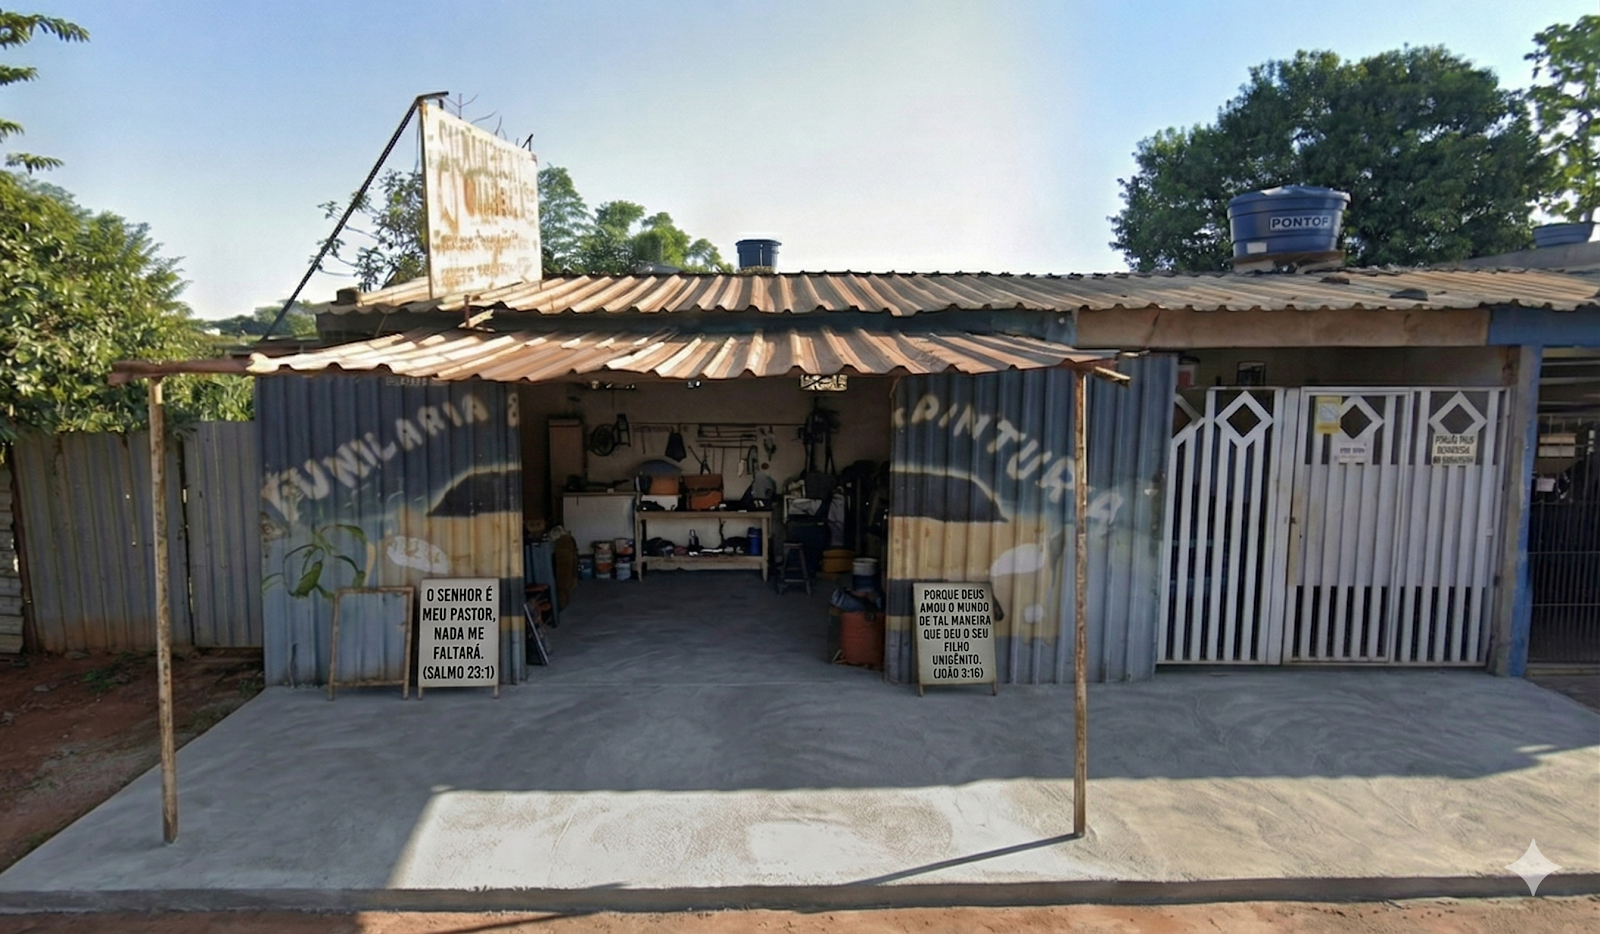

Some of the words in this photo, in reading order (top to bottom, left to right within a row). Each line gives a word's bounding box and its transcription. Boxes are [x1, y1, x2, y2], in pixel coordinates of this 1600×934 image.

[1272, 216, 1329, 228] PONTOF
[261, 394, 489, 524] FUNILARIA
[911, 394, 1124, 525] PINTURA
[426, 588, 435, 602] O
[437, 588, 483, 602] SENHOR
[485, 585, 493, 602] É
[924, 589, 959, 601] PORQUE
[961, 589, 985, 600] DEUS
[920, 602, 946, 613] AMOU
[948, 602, 955, 613] O
[957, 602, 989, 612] MUNDO
[422, 607, 447, 621] MEU
[450, 607, 496, 623] PASTOR,
[919, 615, 931, 626] DE
[933, 615, 949, 626] TAL
[951, 615, 992, 626] MANEIRA
[434, 626, 465, 640] NADA
[468, 626, 485, 640] ME
[923, 629, 941, 640] QUE
[943, 629, 961, 639] DEU
[963, 628, 970, 639] O
[971, 628, 989, 639] SEU
[433, 643, 484, 660] FALTARÁ.
[944, 641, 970, 652] FILHO
[932, 653, 982, 665] UNIGÊNITO.
[422, 665, 464, 680] (SALMO
[467, 665, 495, 680] 23:1)
[933, 666, 959, 679] (JOÃO
[961, 667, 984, 679] 3:16)
